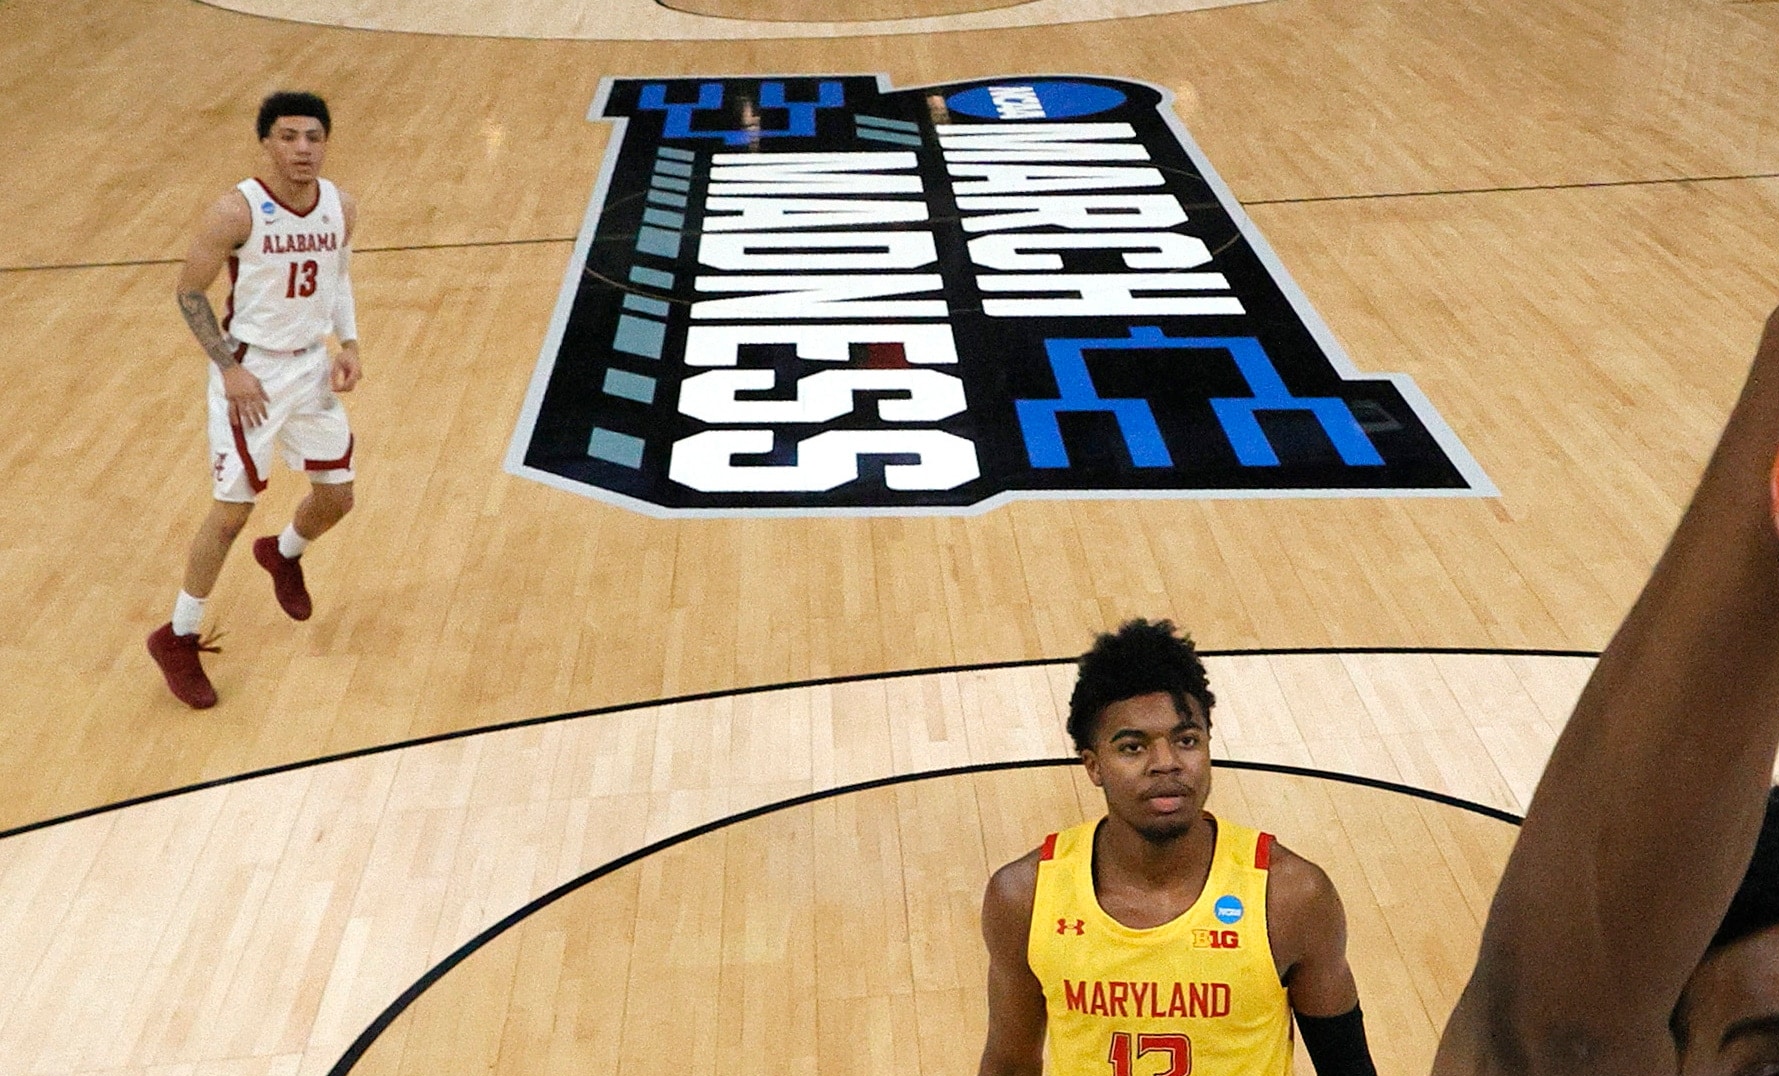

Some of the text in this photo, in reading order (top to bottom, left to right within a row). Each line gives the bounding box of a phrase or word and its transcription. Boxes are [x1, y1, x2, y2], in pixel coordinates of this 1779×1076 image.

[936, 123, 1247, 316] MARCH
[263, 232, 336, 254] ALABAMA
[286, 259, 318, 298] 13
[667, 151, 982, 493] MADNESS
[1063, 979, 1231, 1018] MARYLAND
